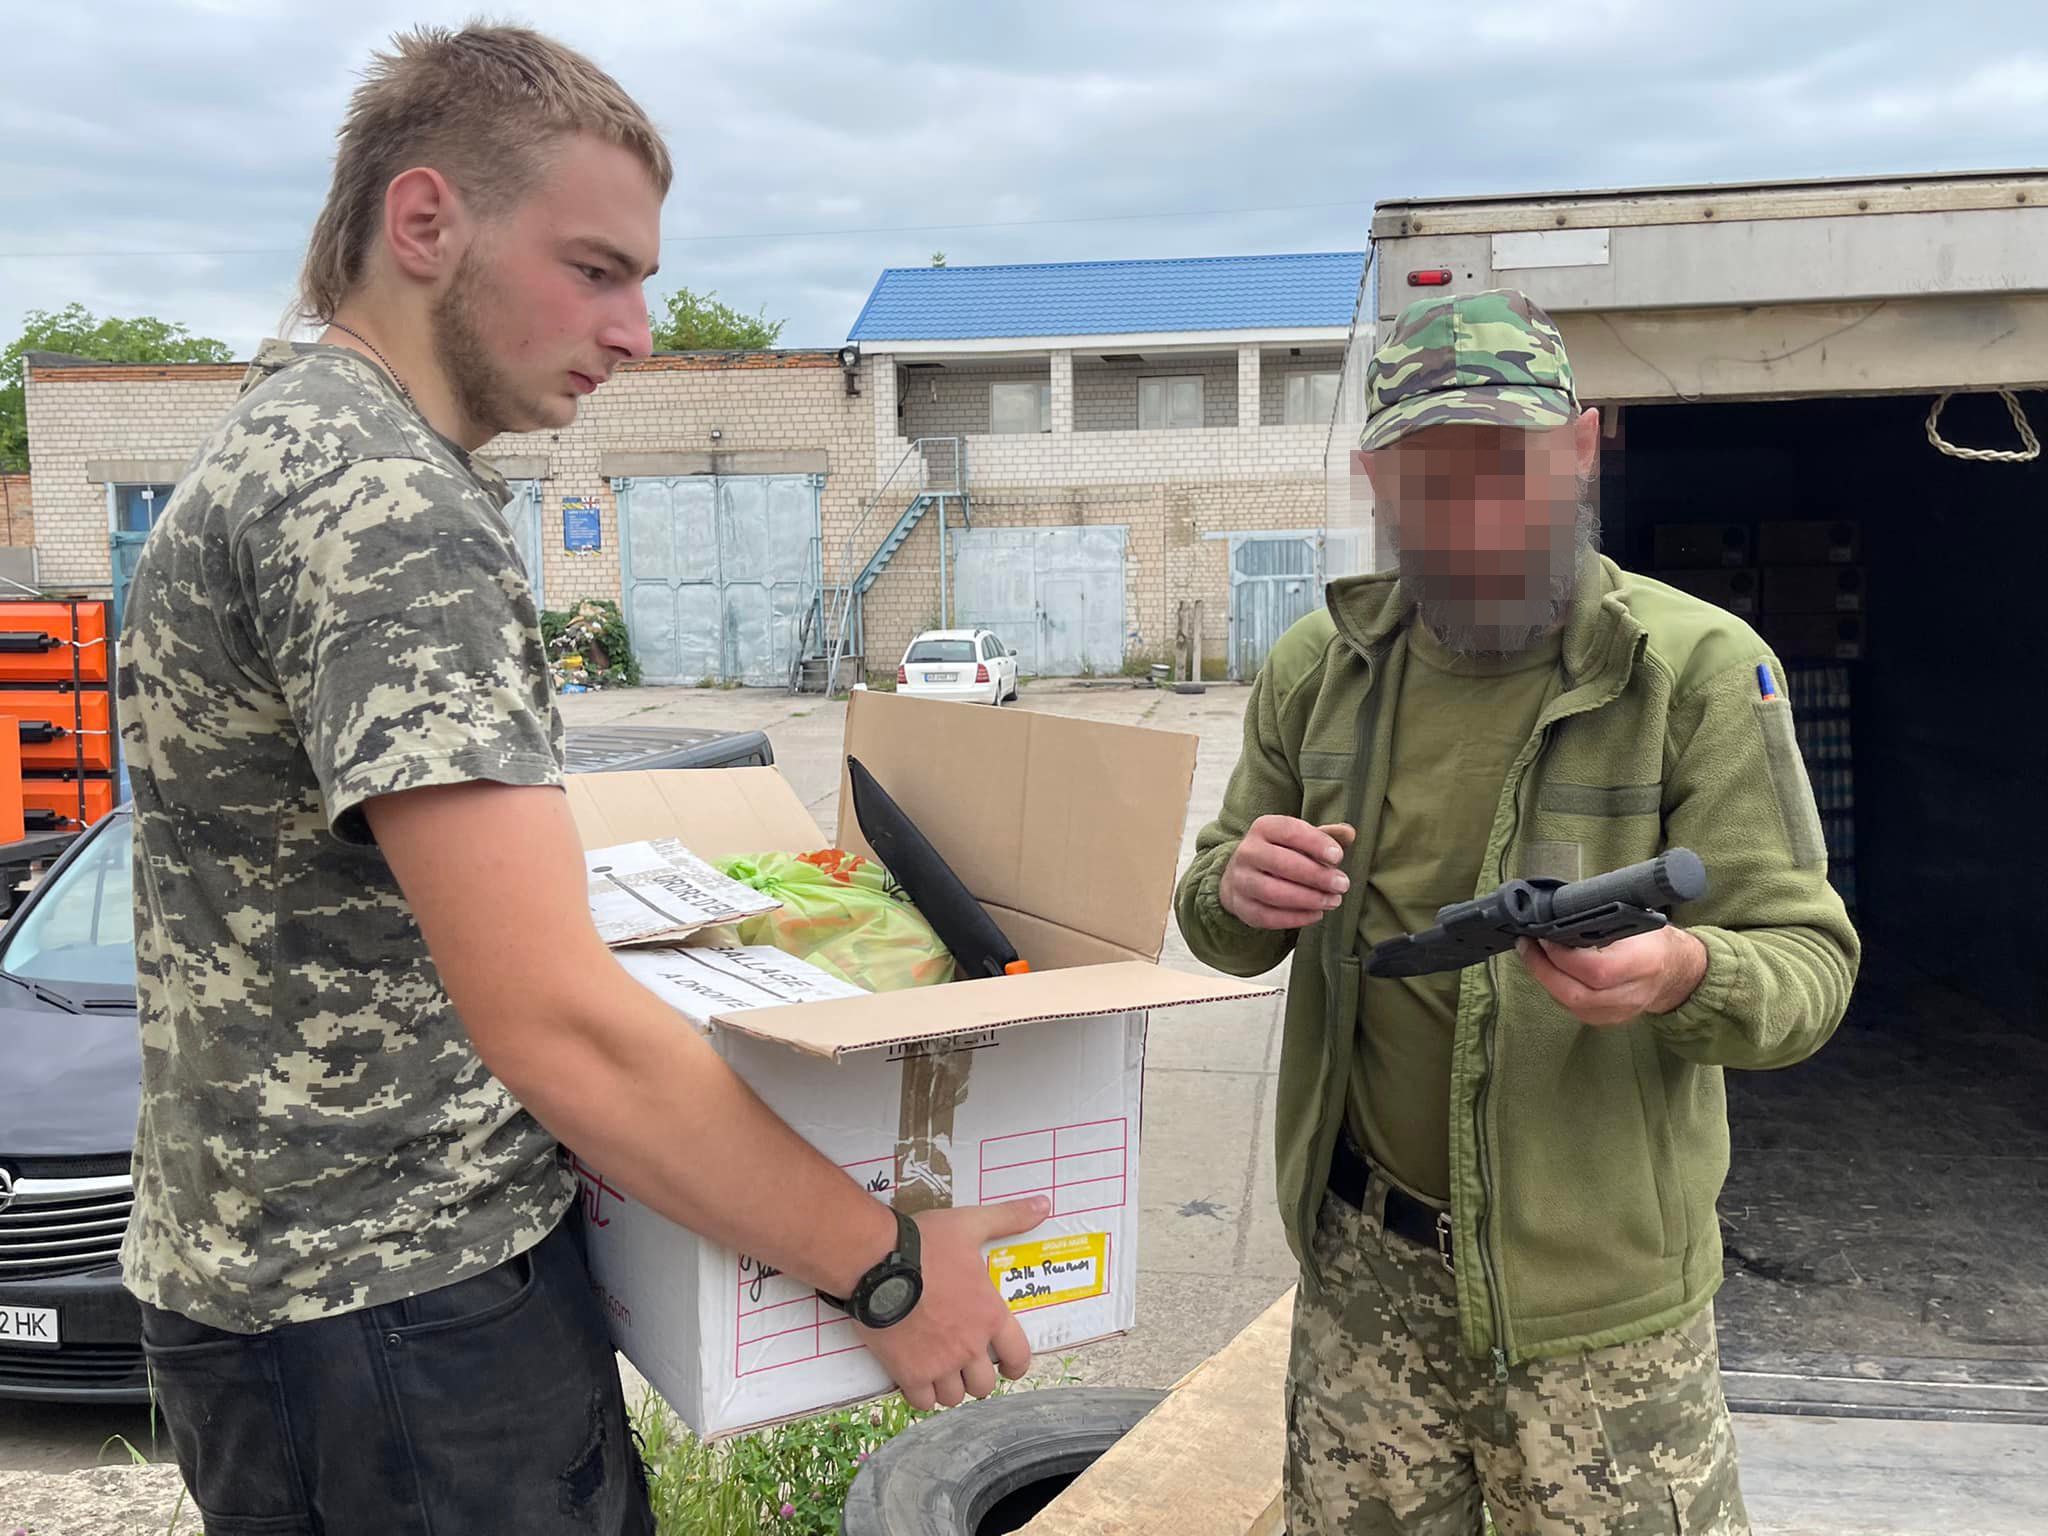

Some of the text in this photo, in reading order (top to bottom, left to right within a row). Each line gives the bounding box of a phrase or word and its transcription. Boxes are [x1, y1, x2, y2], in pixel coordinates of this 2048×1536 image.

[653, 873, 708, 903] ORDRE
[673, 980, 757, 1009] DROITE
[16, 1311, 47, 1337] HK
